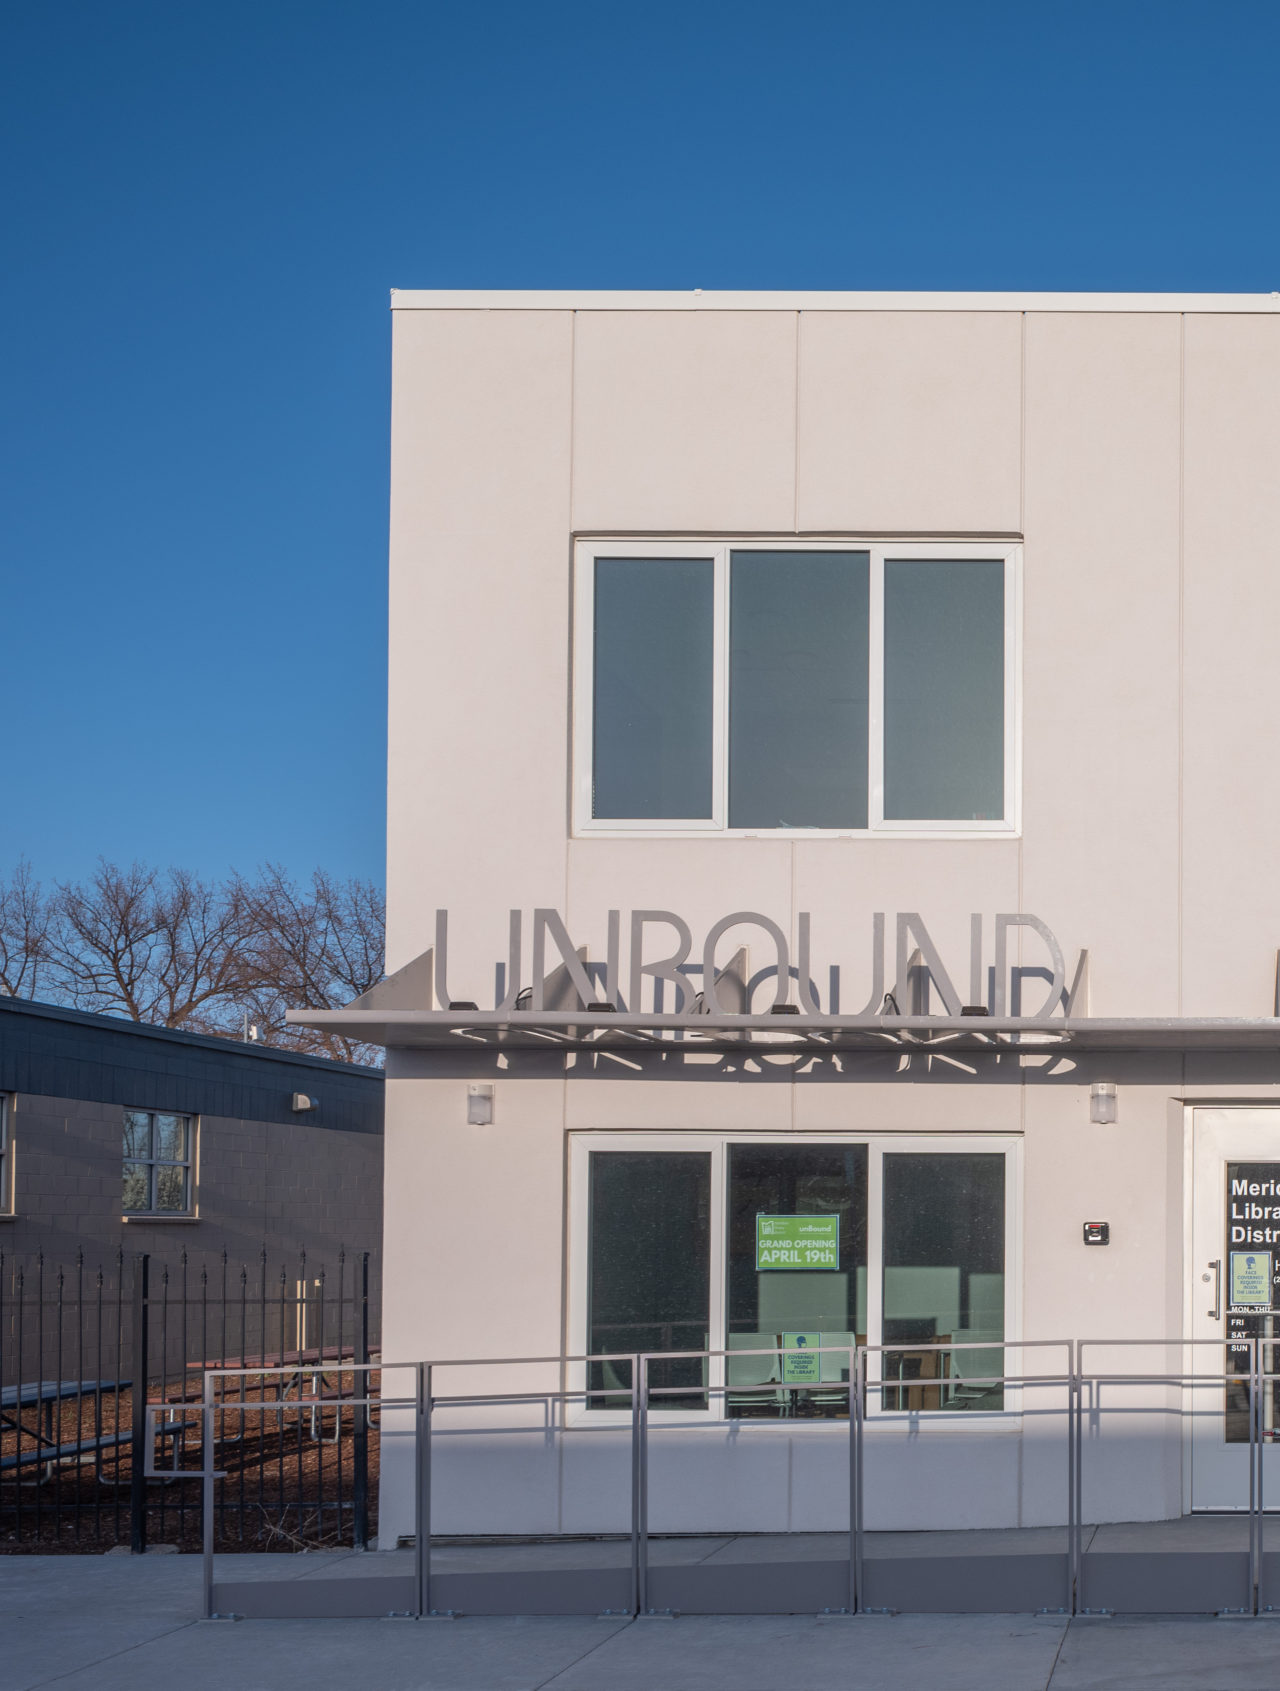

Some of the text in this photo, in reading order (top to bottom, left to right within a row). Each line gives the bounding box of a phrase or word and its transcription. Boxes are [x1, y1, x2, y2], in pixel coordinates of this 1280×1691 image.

[435, 908, 1066, 1017] UNBOUND
[759, 1239, 835, 1248] GRAND OPENING
[760, 1249, 834, 1263] APRIL 19th
[1231, 1331, 1246, 1339] SAT
[1231, 1344, 1248, 1352] SUN
